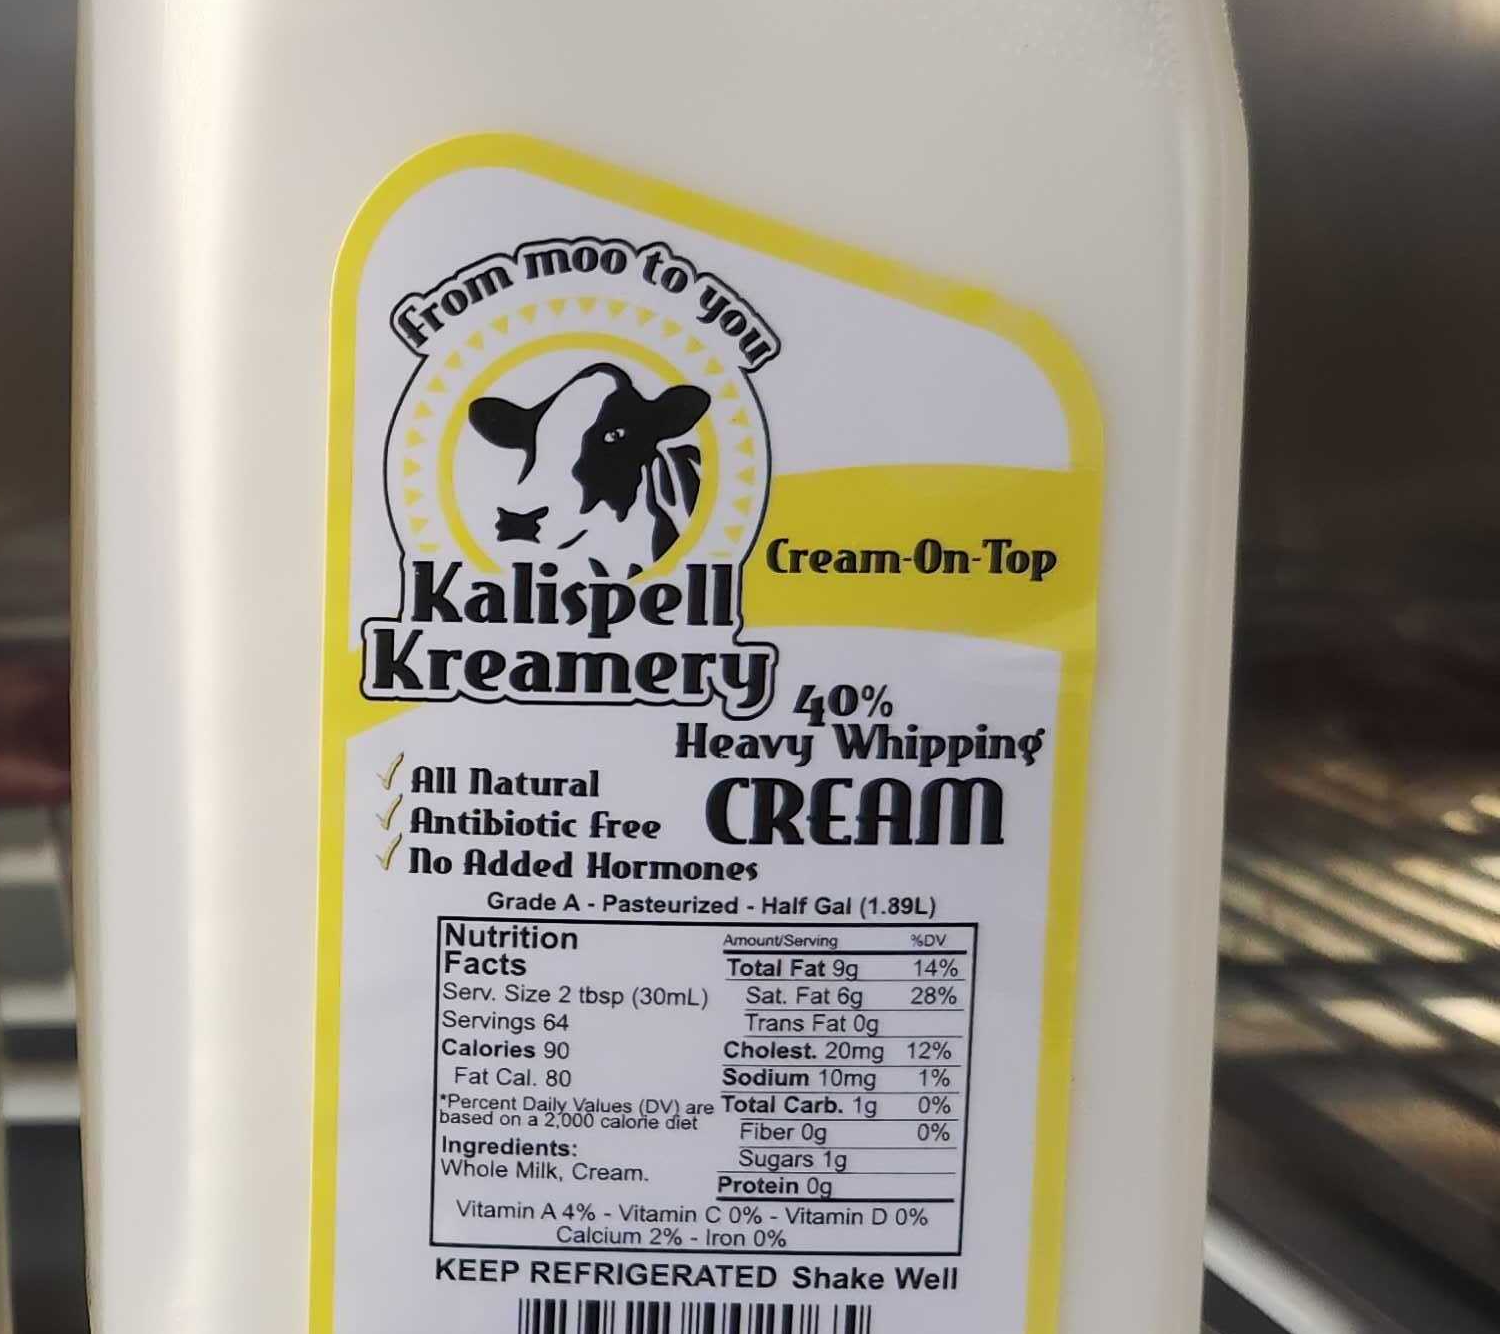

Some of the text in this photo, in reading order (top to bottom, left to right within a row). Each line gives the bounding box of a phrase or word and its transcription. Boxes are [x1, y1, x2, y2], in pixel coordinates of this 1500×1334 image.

[524, 247, 627, 279] moo
[643, 250, 688, 293] to
[696, 285, 771, 364] you
[766, 538, 1057, 580] Cream-On-Top
[411, 561, 734, 637] Kalispell
[371, 629, 768, 707] Kreamery
[793, 684, 893, 726] 40%
[675, 722, 1045, 766] Heavy Whipping
[411, 765, 599, 797] All Natural
[410, 806, 577, 838] Antibiotic
[705, 777, 1003, 845] CREAM
[409, 847, 759, 882] No Added Hormones
[487, 891, 557, 912] Grade
[562, 893, 580, 912] A
[602, 894, 739, 915] Pasteurized
[761, 896, 805, 915] Half
[812, 896, 851, 916] Gal
[860, 896, 936, 918] (1.89L)
[444, 925, 578, 950] Nutrition
[724, 935, 947, 948] Amount/Serving %DV
[444, 952, 526, 978] Facts
[727, 959, 958, 981] Total Fat 9g 14%
[746, 987, 956, 1008] Sat. Fat 6g 28%
[745, 1014, 878, 1036] Trans Fat 0g
[442, 1039, 569, 1060] Calories 90
[725, 1041, 951, 1063] Cholest. 20mg 12%
[722, 1068, 950, 1090] Sodium 10mg 1%
[722, 1096, 950, 1118] Total Carb. 1g 0%
[740, 1123, 949, 1145] Fiber 0g 0%
[739, 1149, 847, 1171] Sugars 1g
[718, 1176, 832, 1198] Protein 0g
[556, 1227, 641, 1245] Calcium
[650, 1229, 682, 1246] 2%
[706, 1229, 745, 1246] Iron
[754, 1230, 786, 1248] 0%
[436, 1259, 957, 1290] KEEP REFRIGERATED Shake Well
